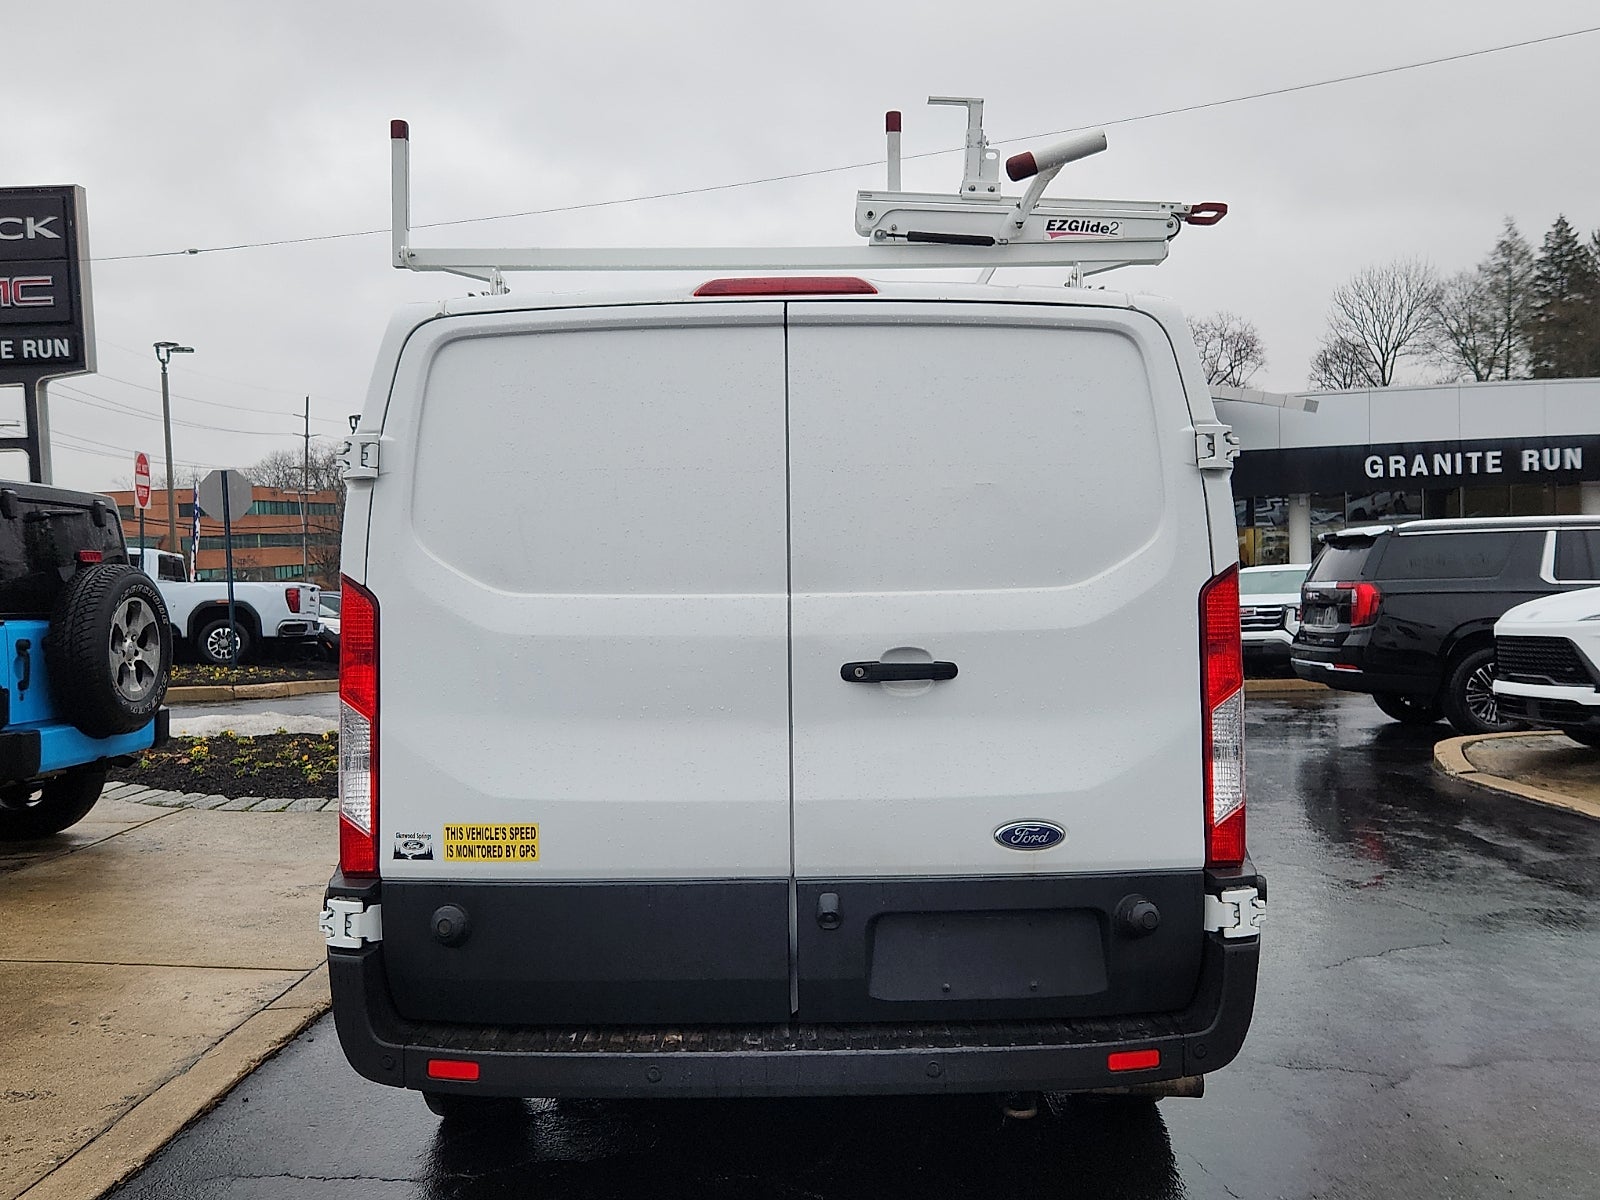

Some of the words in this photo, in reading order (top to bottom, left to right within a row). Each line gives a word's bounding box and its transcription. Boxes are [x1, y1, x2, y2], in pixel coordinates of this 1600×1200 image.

[22, 338, 70, 358] RUN
[1364, 451, 1502, 478] GRANITE
[1521, 447, 1583, 472] RUN
[445, 827, 464, 841] THIS
[465, 827, 507, 841] VEHICLE'S
[509, 827, 536, 841] SPEED
[1010, 827, 1050, 844] Ford
[446, 844, 454, 858] IS
[456, 844, 503, 859] MONITORED
[505, 844, 517, 858] BY
[519, 844, 536, 858] GPS
